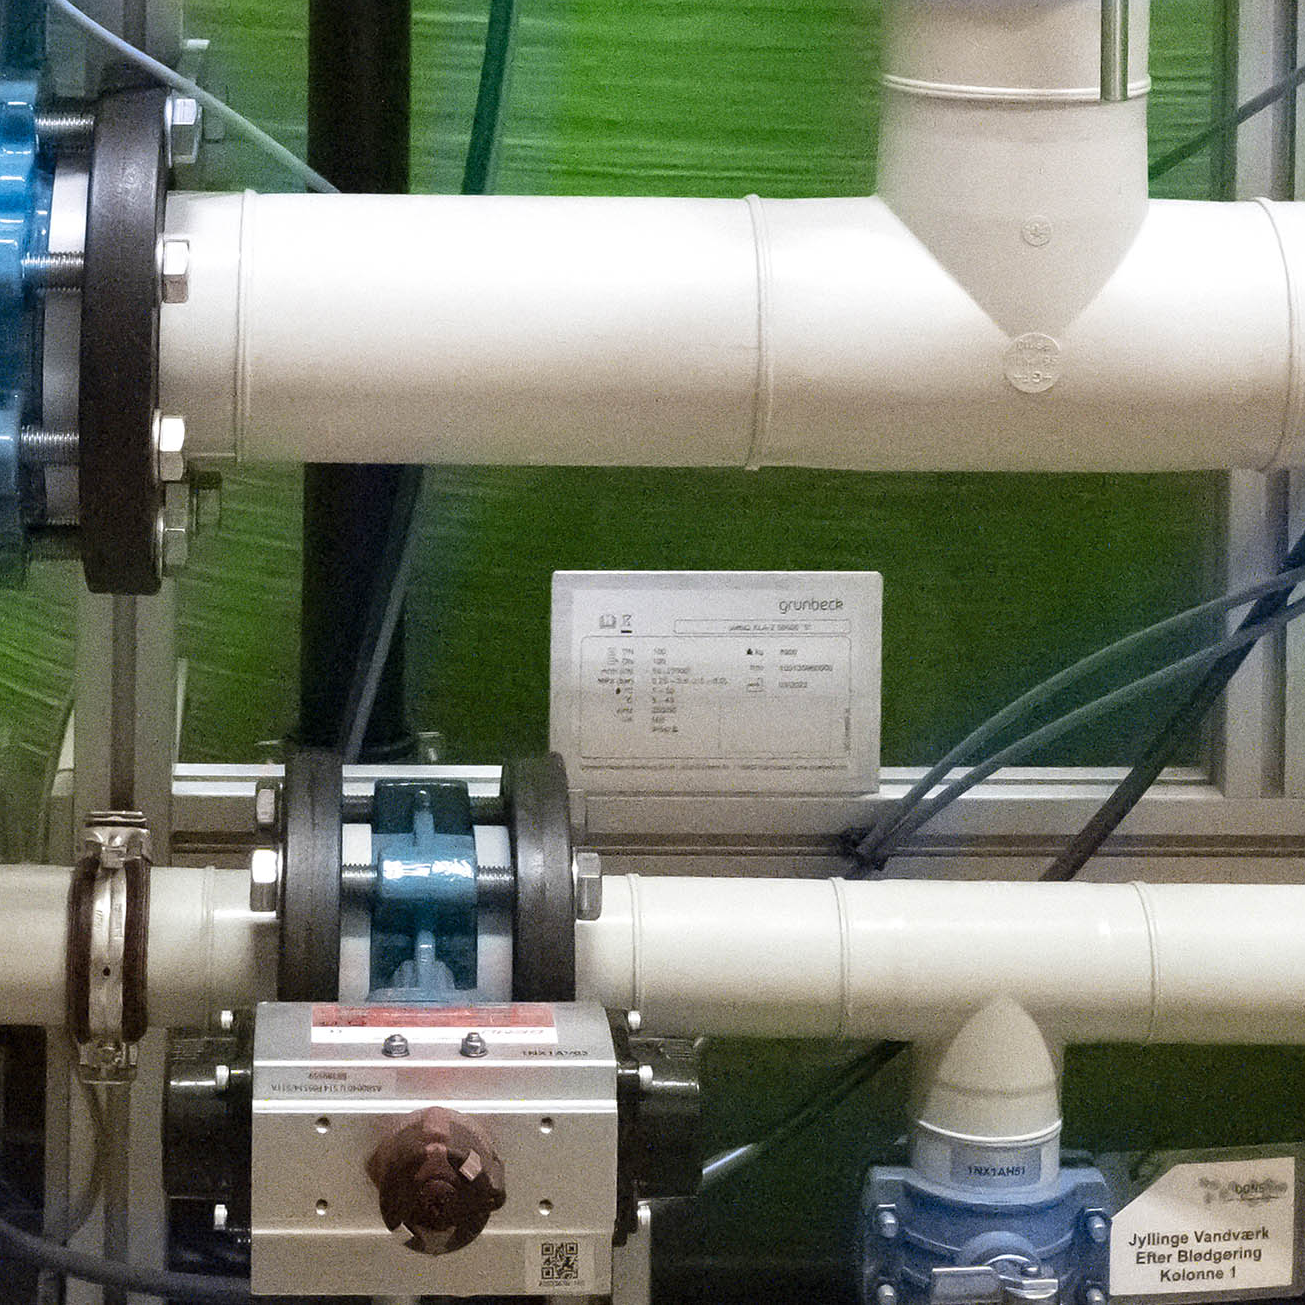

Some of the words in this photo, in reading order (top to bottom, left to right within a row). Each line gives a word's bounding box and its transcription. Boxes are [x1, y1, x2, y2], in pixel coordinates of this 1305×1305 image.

[1128, 1232, 1189, 1249] Jyllinge
[1194, 1226, 1270, 1243] Vandværk
[1136, 1251, 1173, 1265] Efter
[1178, 1247, 1262, 1264] Blødgøring
[1160, 1268, 1225, 1282] Kolonne
[1230, 1266, 1237, 1278] 1
